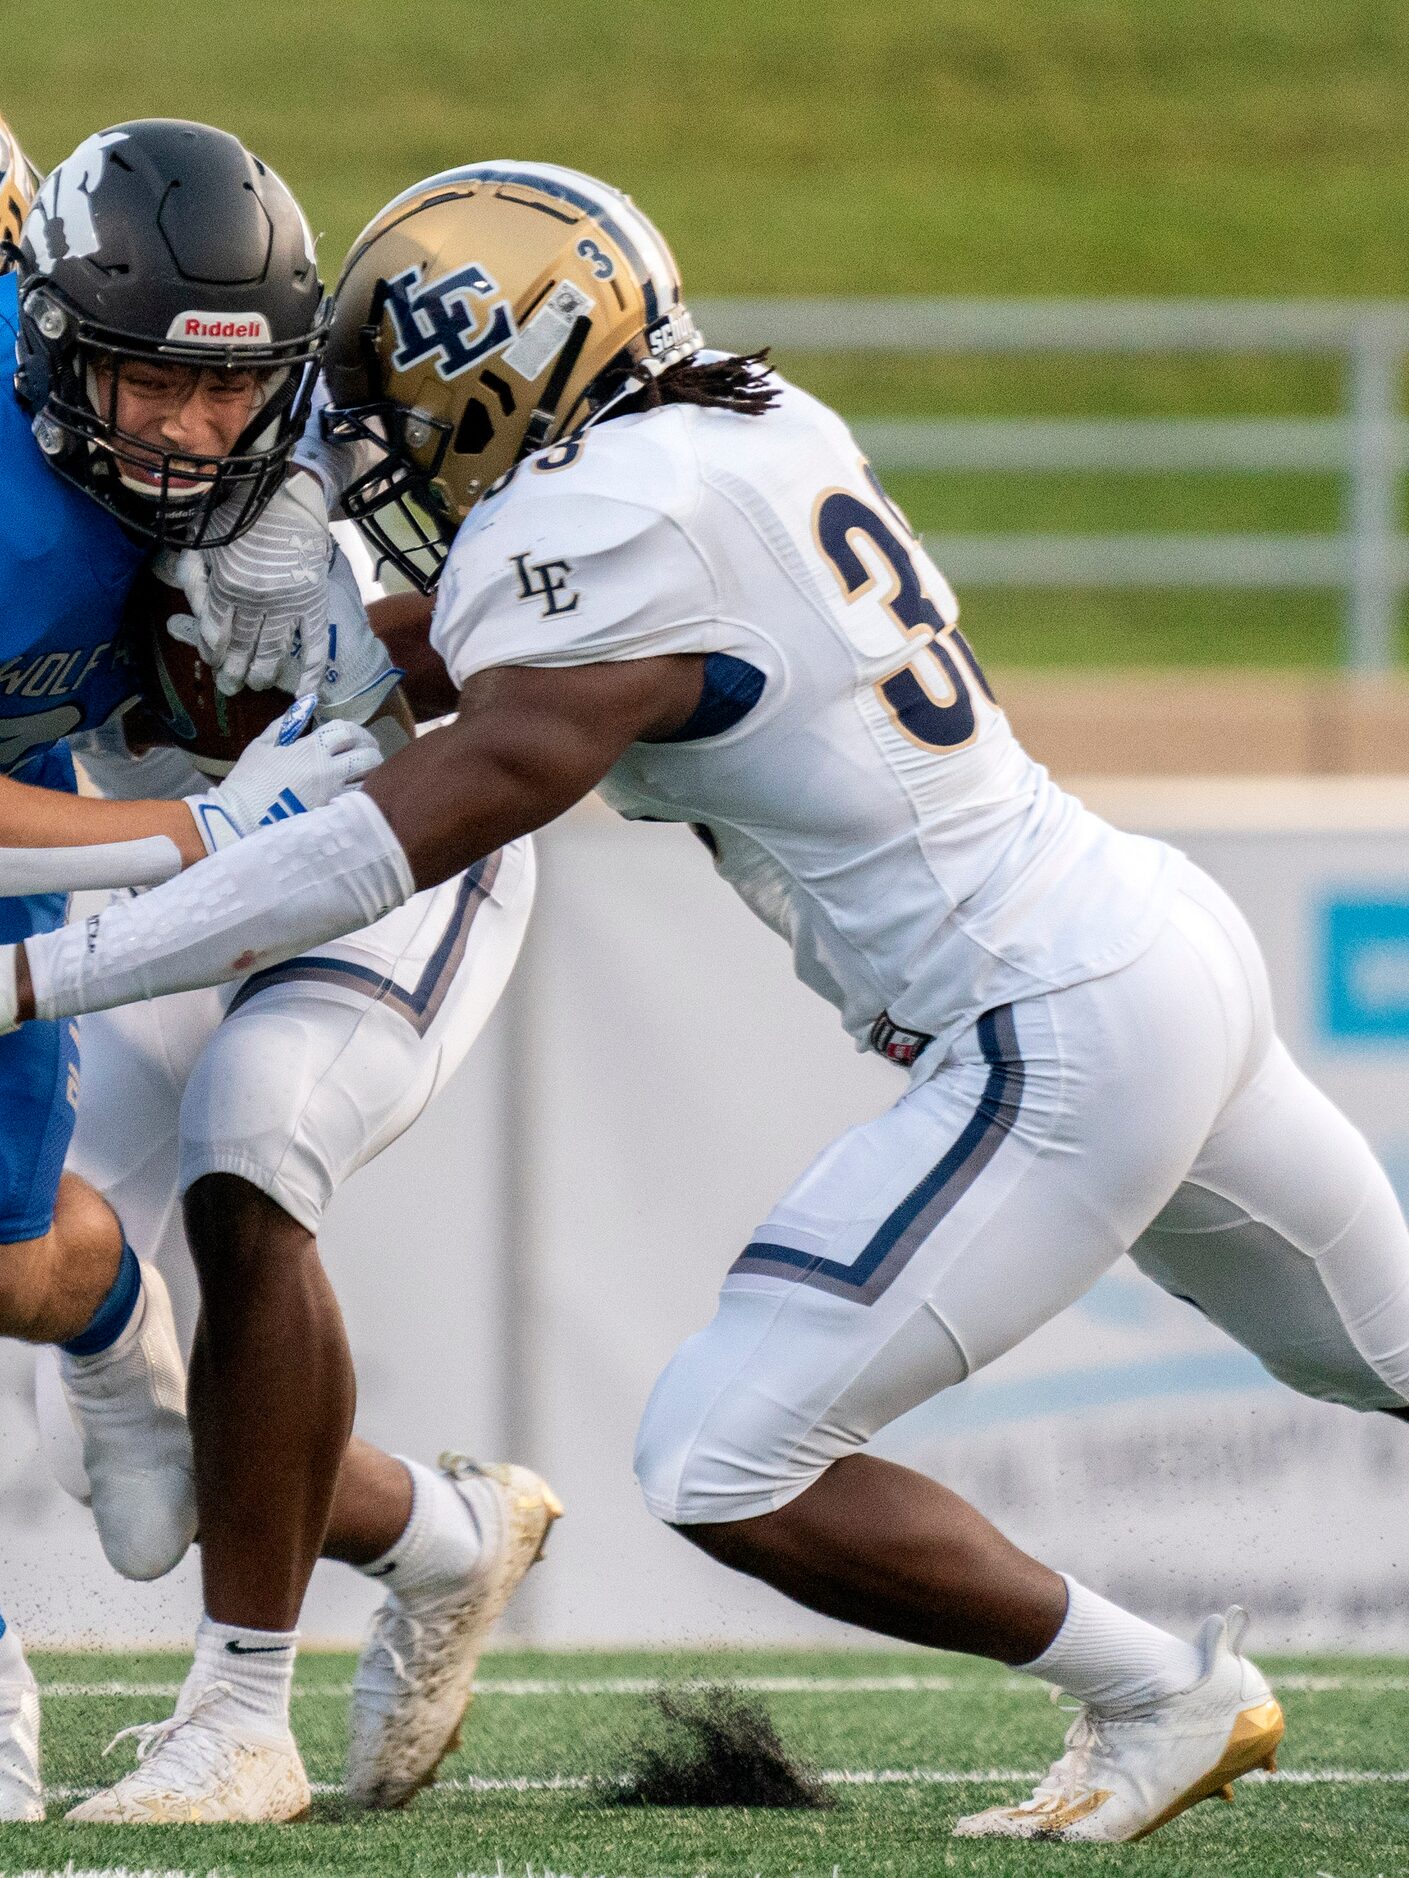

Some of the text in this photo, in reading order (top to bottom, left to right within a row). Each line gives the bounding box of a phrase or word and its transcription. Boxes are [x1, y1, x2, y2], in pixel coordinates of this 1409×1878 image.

[577, 238, 614, 281] 3
[185, 318, 261, 337] Riddell
[385, 262, 520, 381] LE
[507, 551, 583, 619] LE
